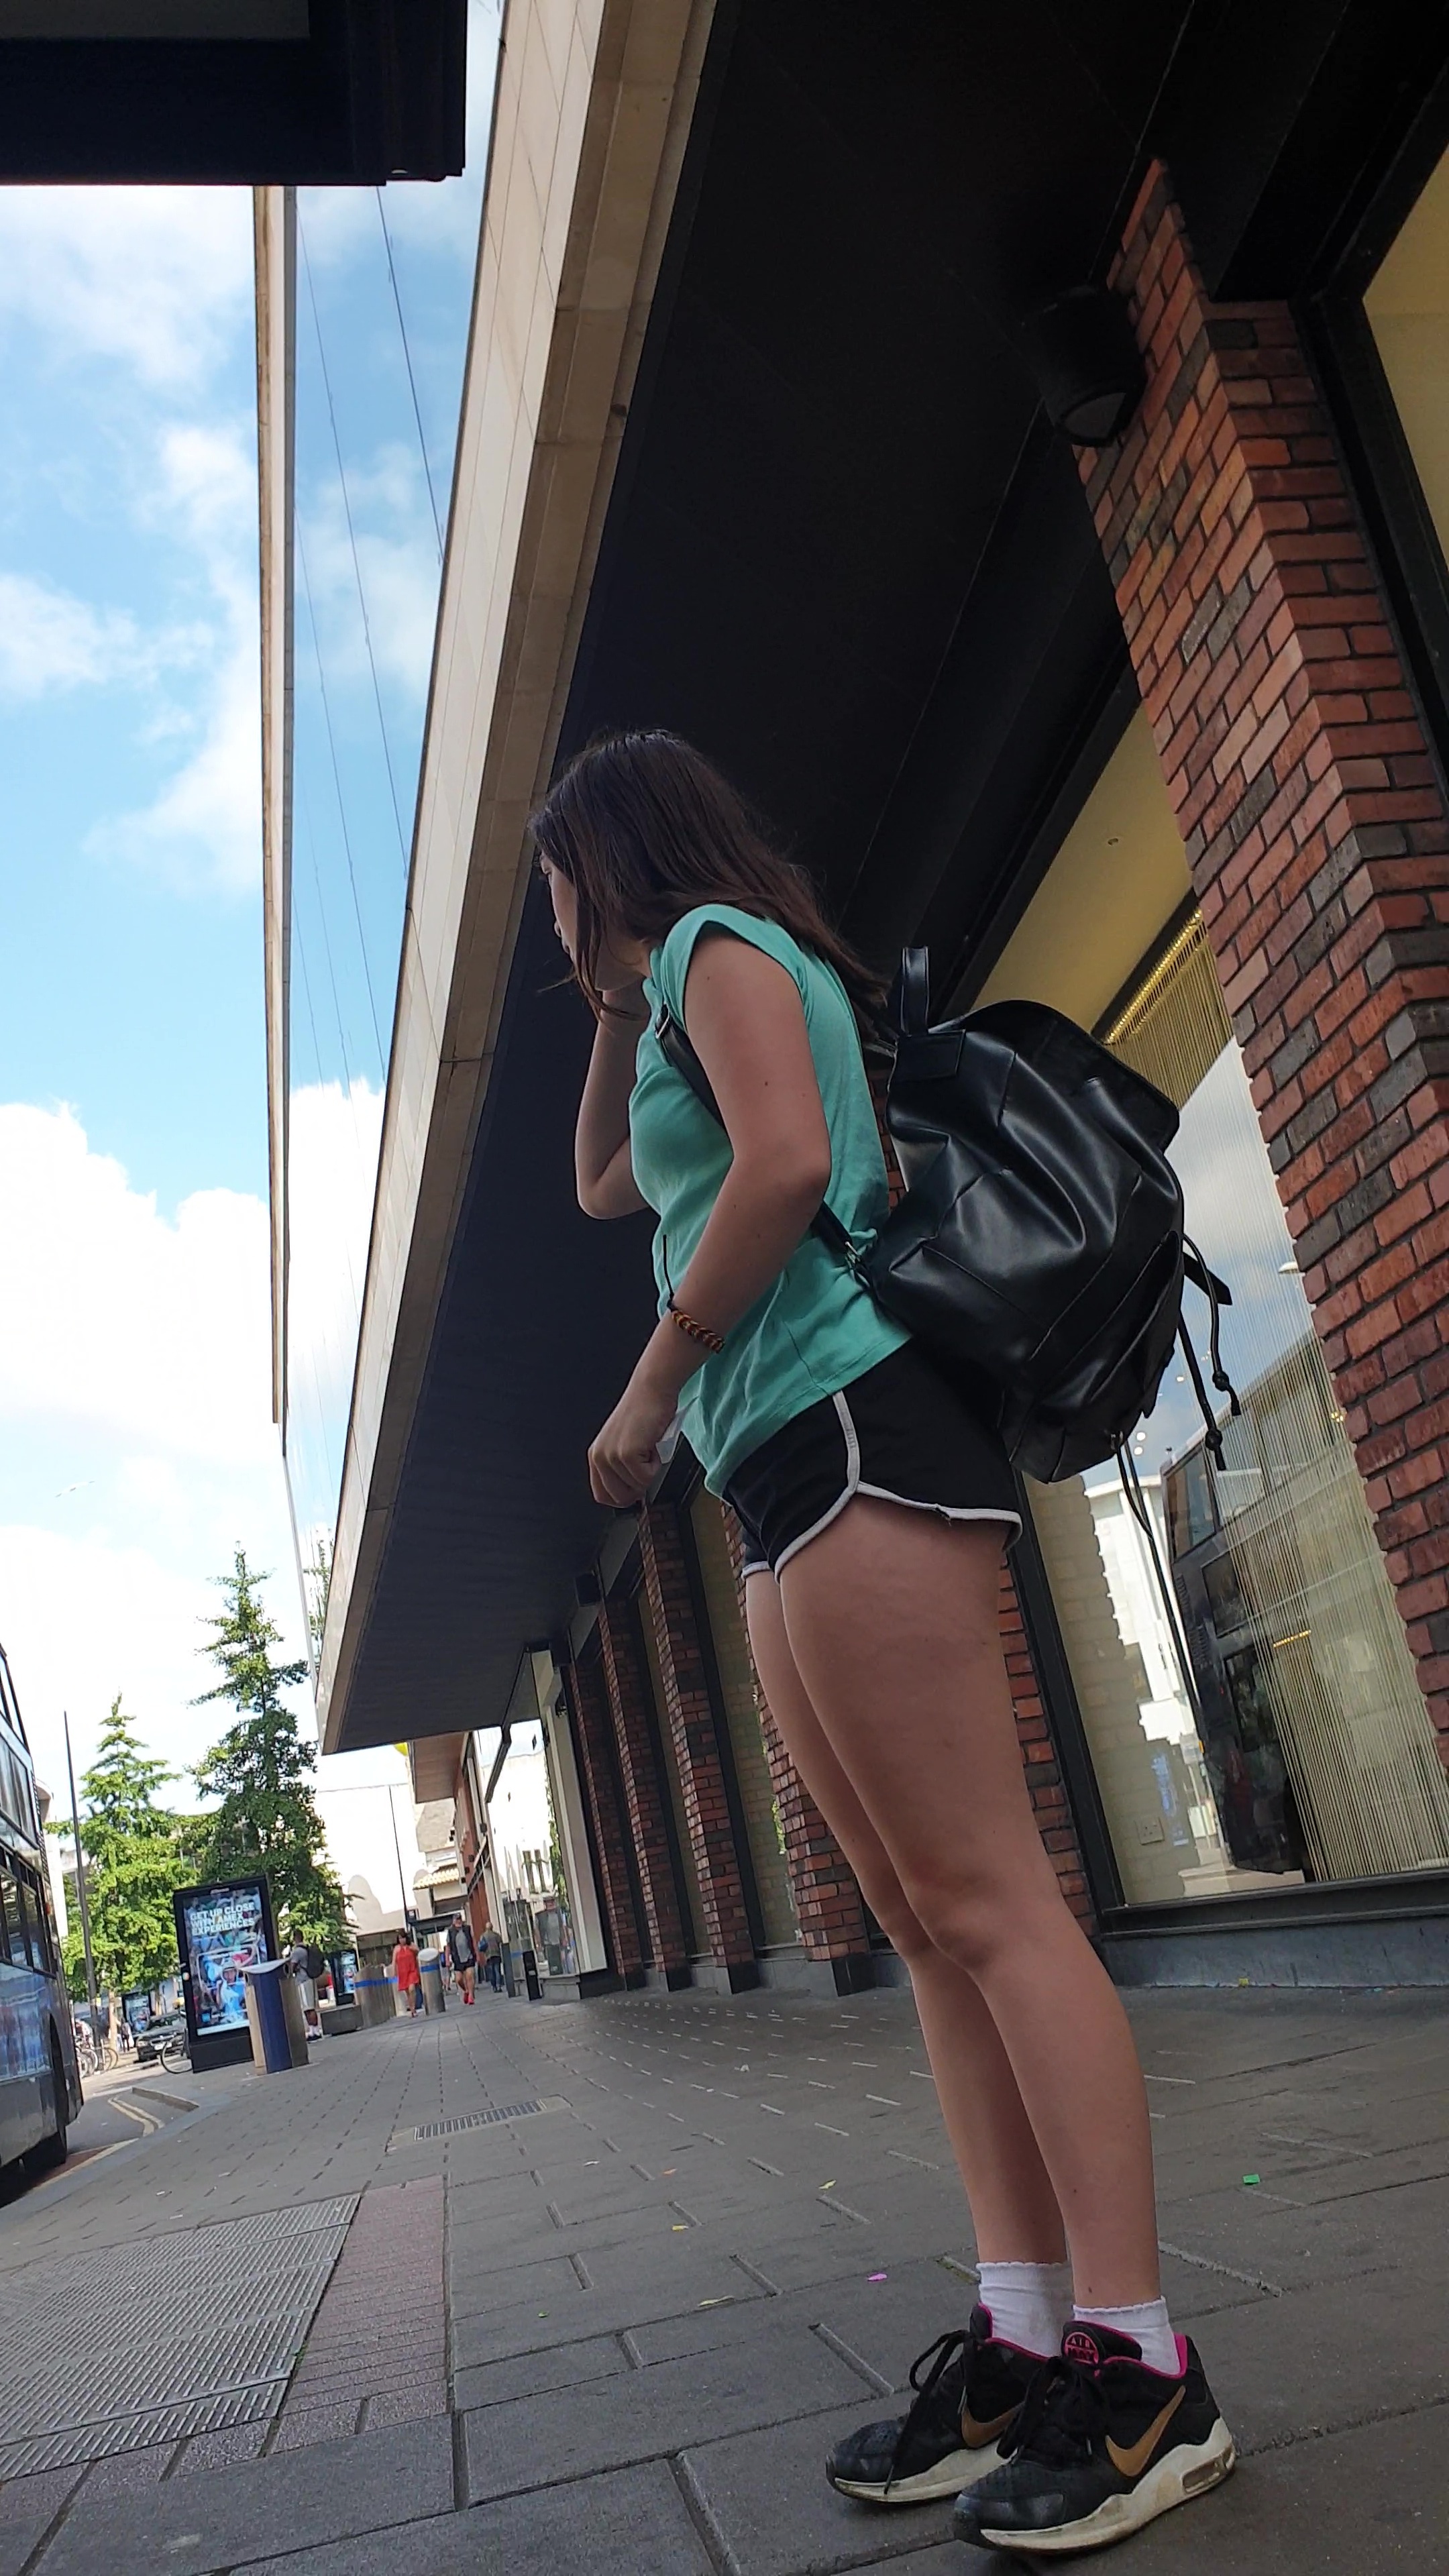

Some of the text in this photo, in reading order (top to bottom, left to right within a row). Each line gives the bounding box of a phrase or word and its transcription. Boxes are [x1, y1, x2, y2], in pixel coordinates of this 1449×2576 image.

[191, 1902, 255, 1921] GET UP CLOSE
[191, 1913, 243, 1927] WITH AMEX
[192, 1918, 255, 1935] EXPERIENCES
[1071, 2337, 1090, 2349] AIR
